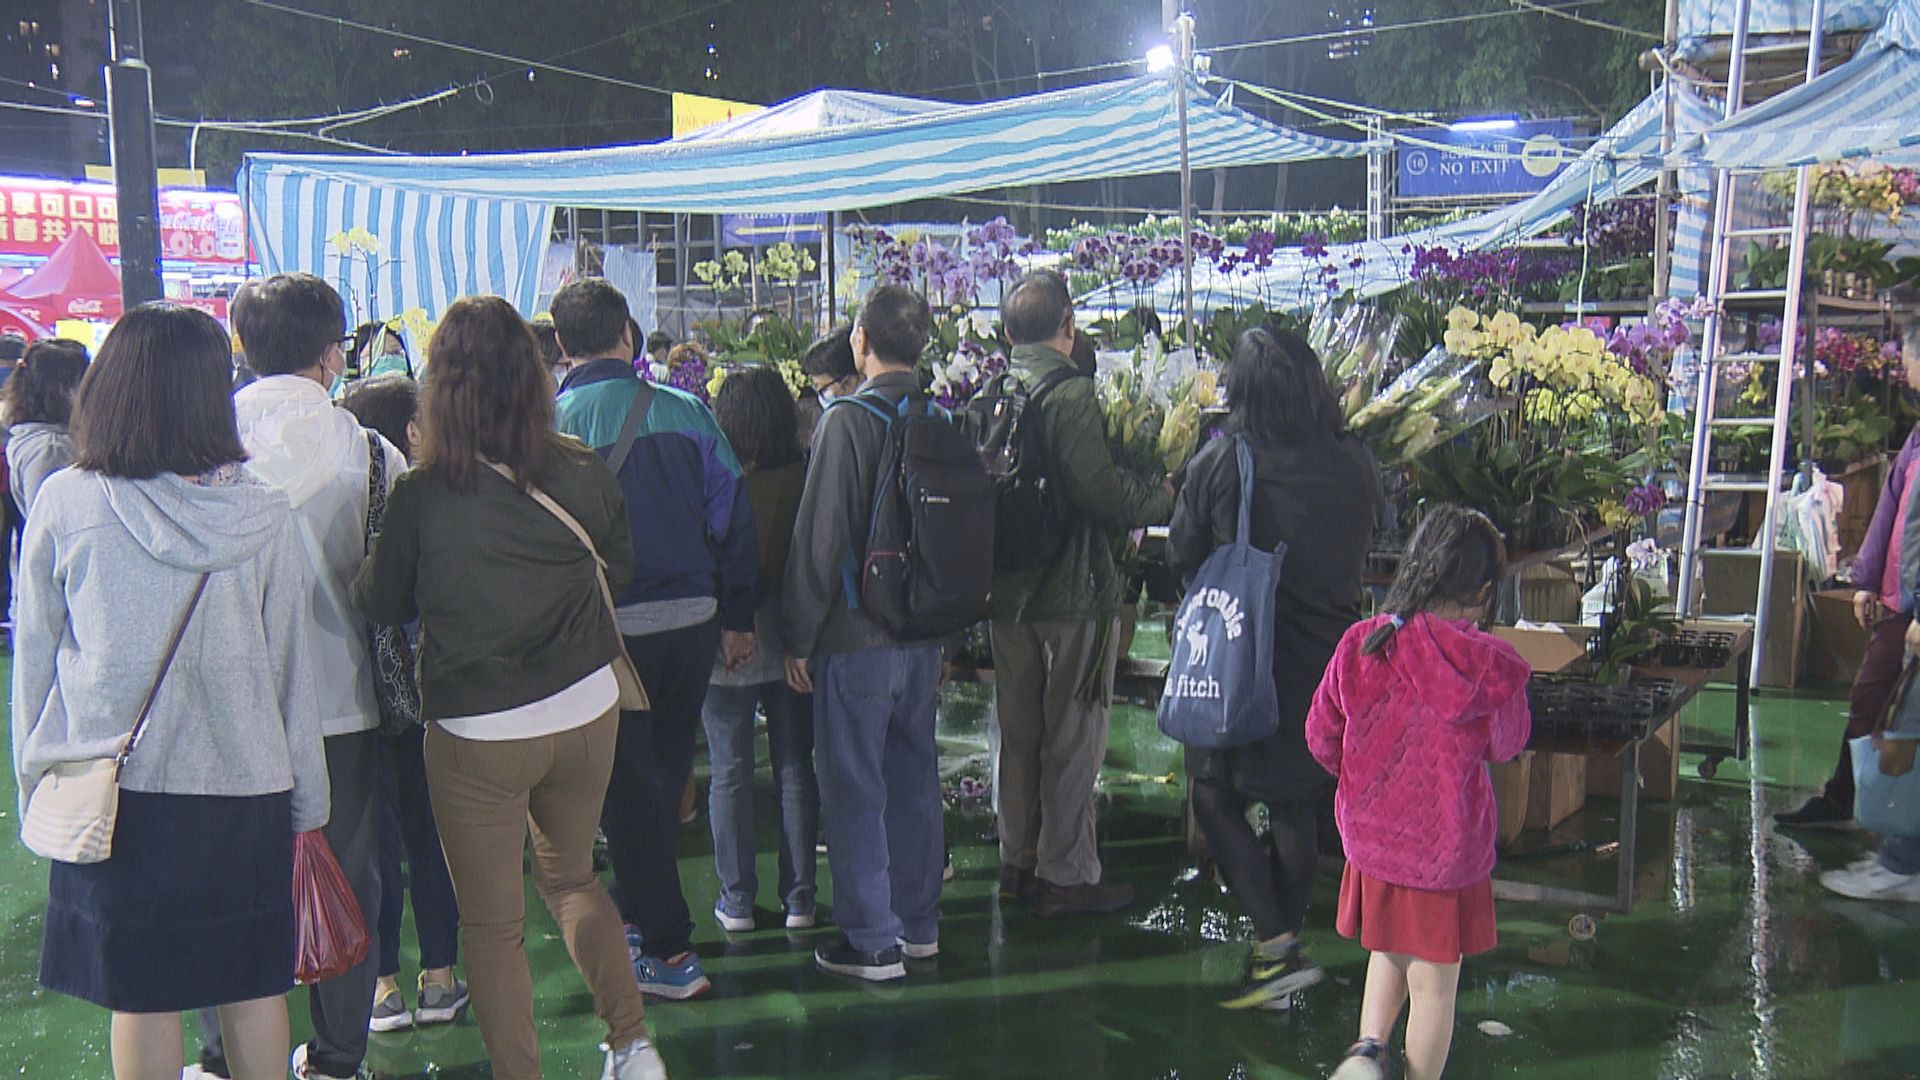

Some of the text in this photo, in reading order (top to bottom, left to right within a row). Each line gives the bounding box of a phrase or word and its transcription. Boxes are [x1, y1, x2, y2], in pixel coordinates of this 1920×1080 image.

[1440, 160, 1507, 175] NO EXIT
[0, 191, 117, 220] 享可口可
[1176, 675, 1220, 698] fitch
